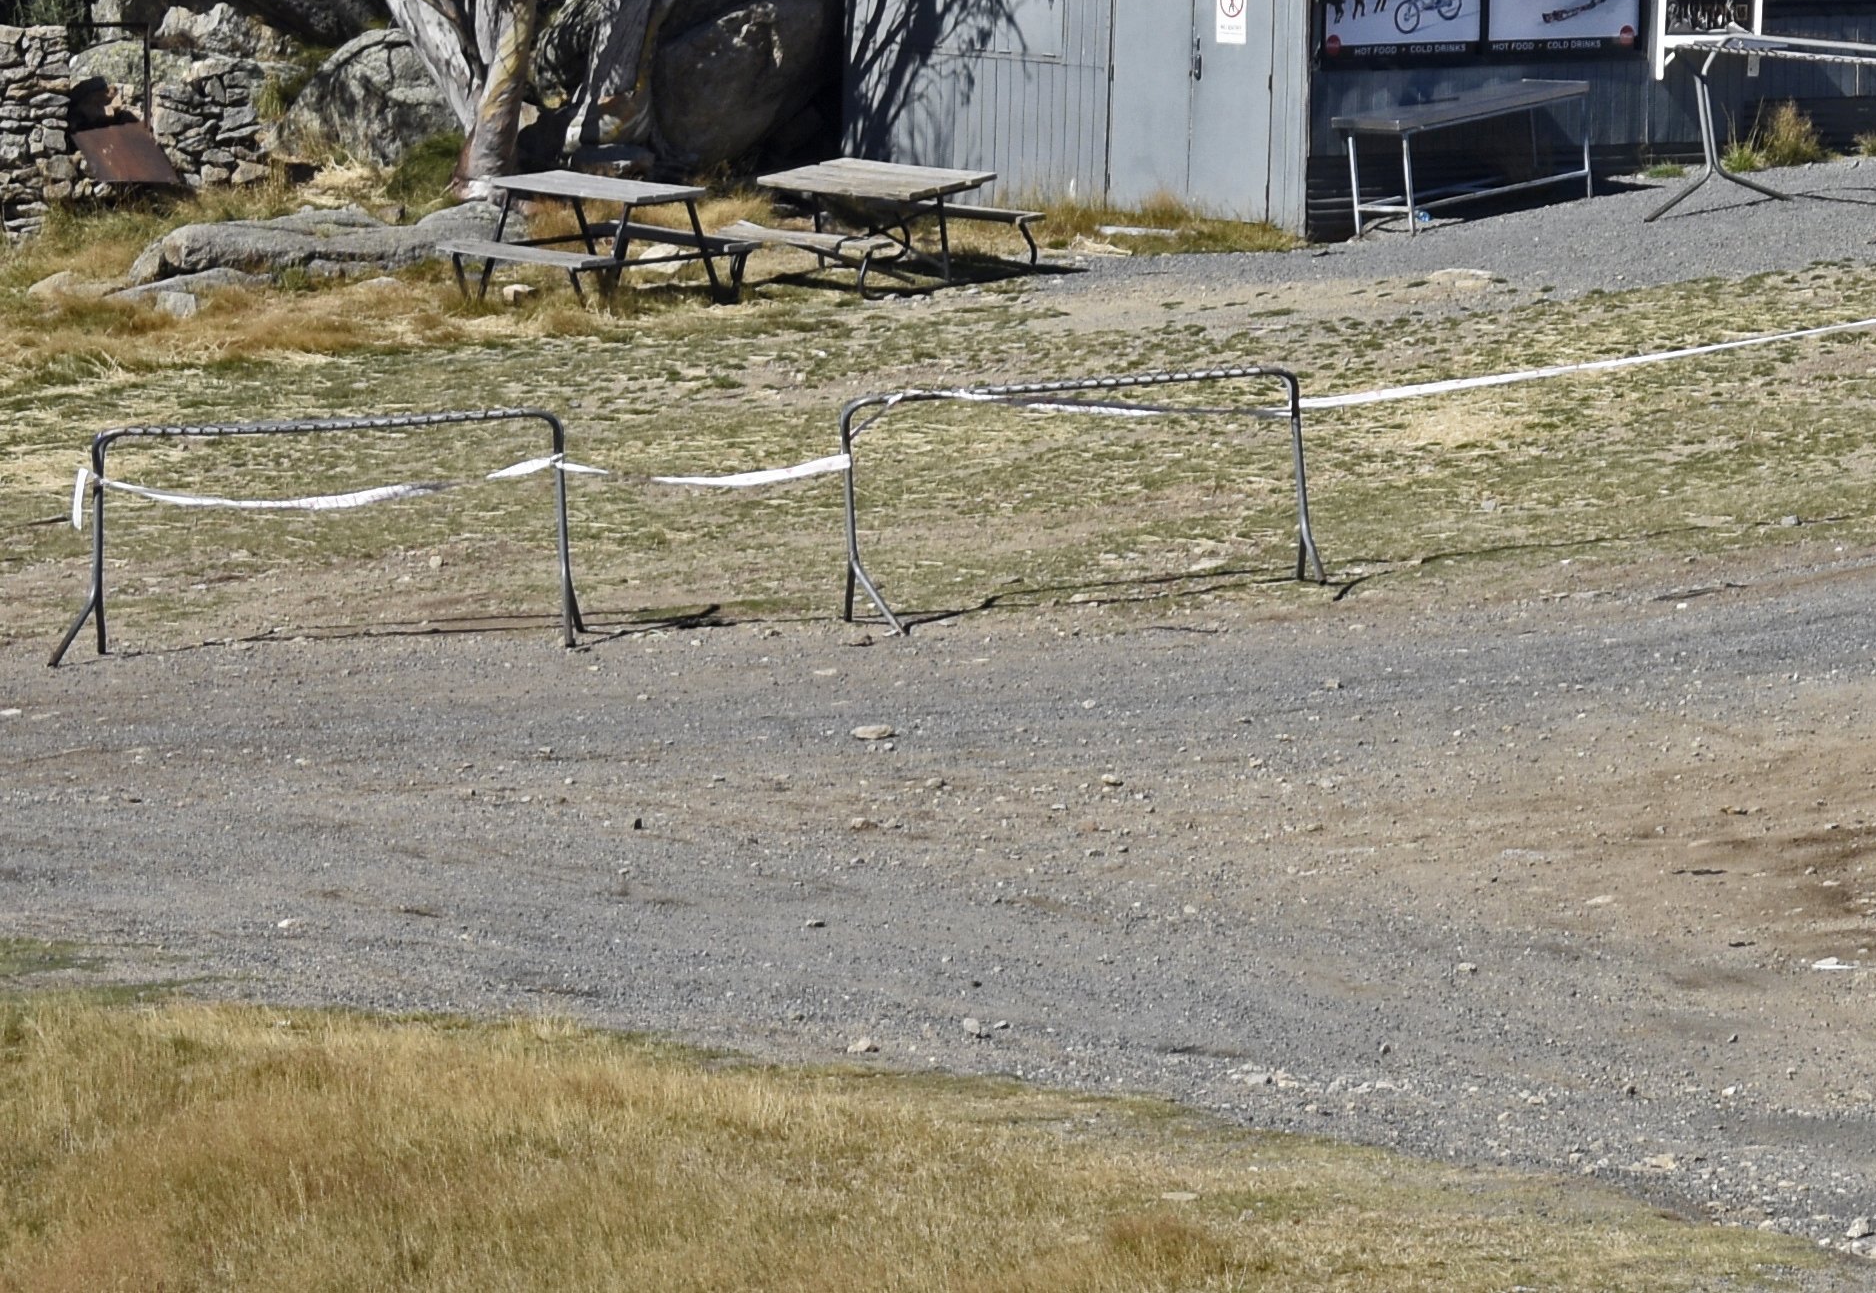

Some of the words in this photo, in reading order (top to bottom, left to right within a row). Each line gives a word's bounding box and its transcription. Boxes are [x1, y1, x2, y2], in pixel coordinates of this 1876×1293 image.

[1354, 47, 1371, 56] HOT
[1374, 46, 1397, 55] FOOD
[1410, 44, 1432, 53] COLD
[1434, 43, 1466, 53] DRINKS
[1492, 43, 1509, 51] HOT
[1511, 42, 1534, 51] FOOD
[1547, 41, 1569, 49] COLD
[1570, 40, 1601, 49] DRINKS
